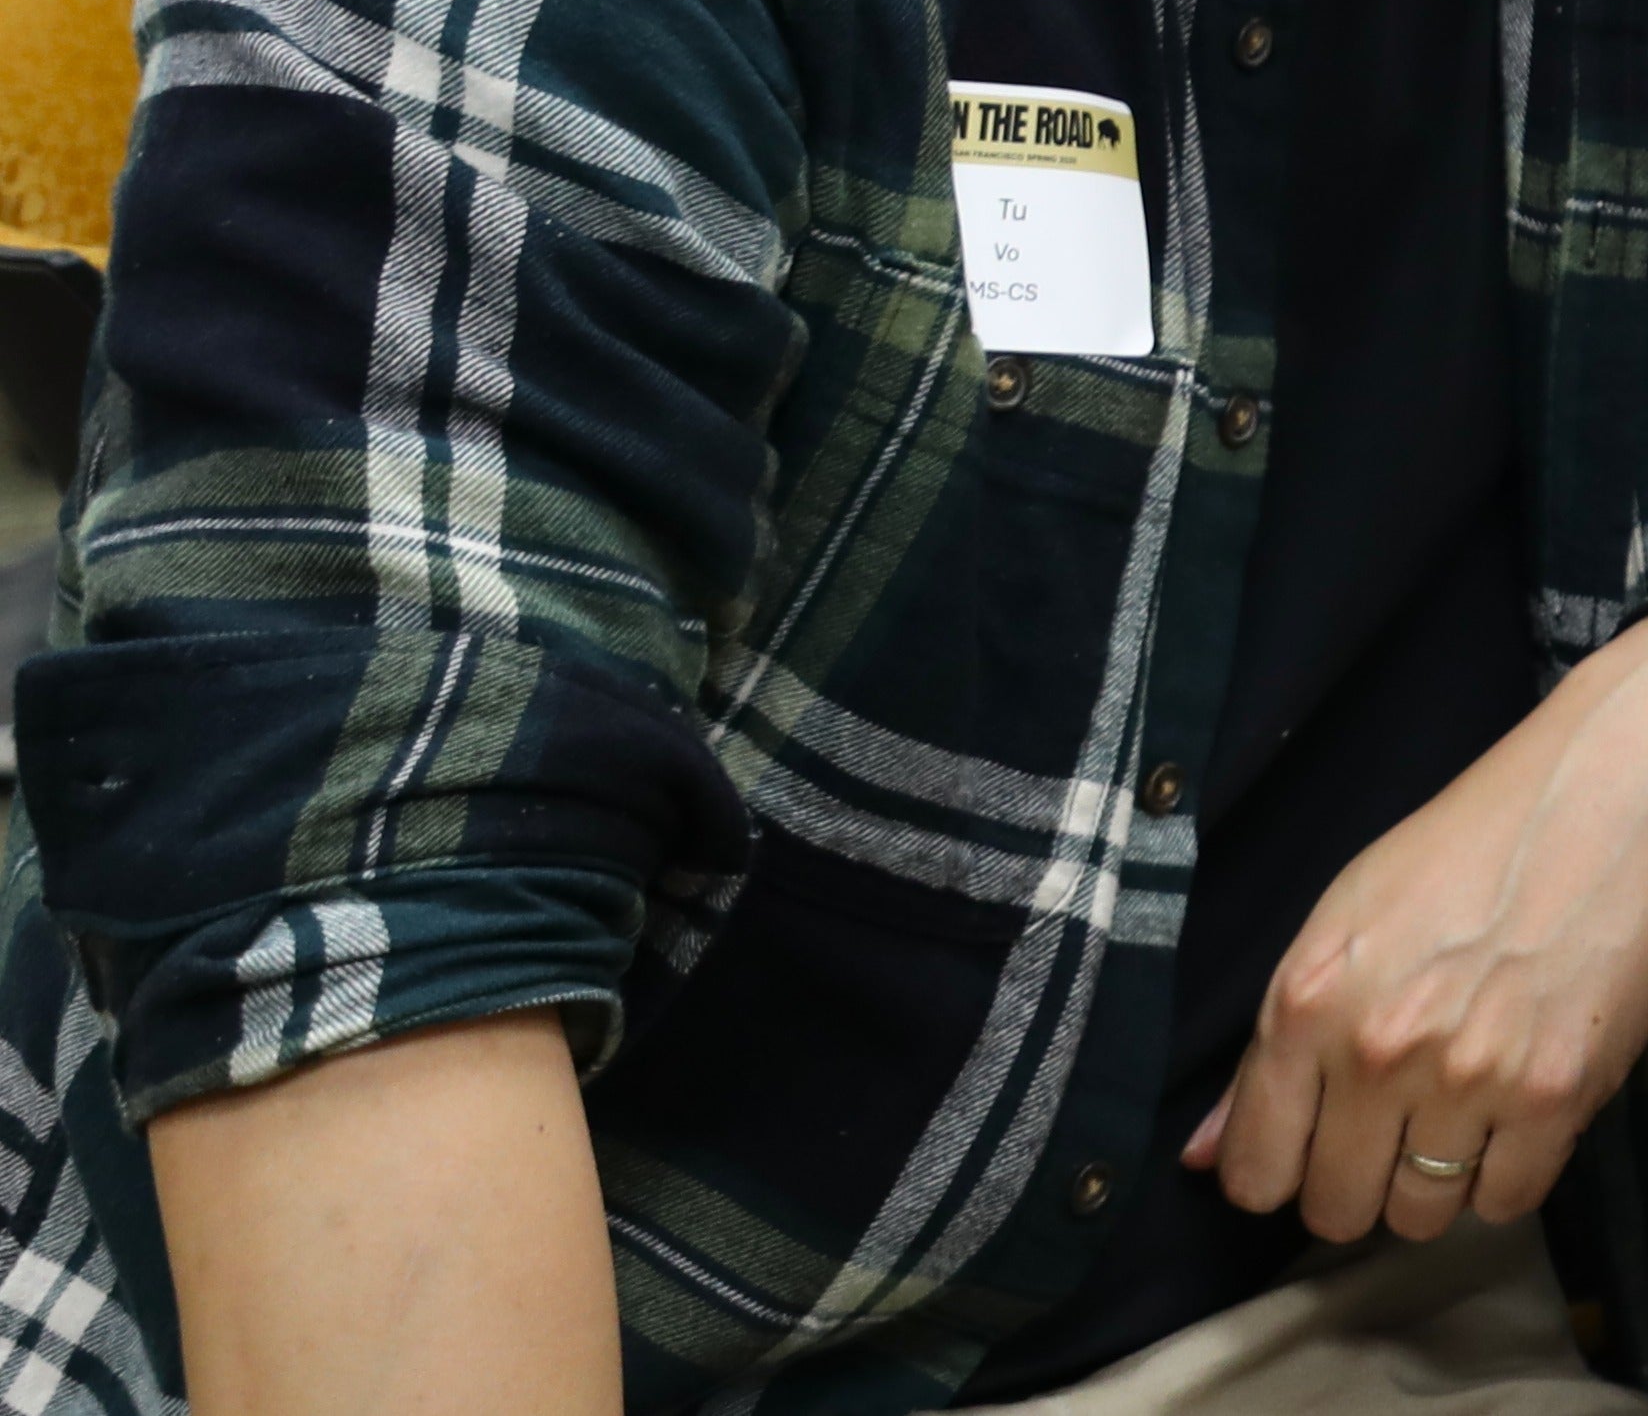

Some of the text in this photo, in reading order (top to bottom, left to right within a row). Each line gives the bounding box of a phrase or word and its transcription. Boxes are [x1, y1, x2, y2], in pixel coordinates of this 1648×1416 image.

[953, 100, 1093, 149] N THE ROAD
[998, 197, 1027, 221] Tu
[993, 241, 1020, 263] Vo
